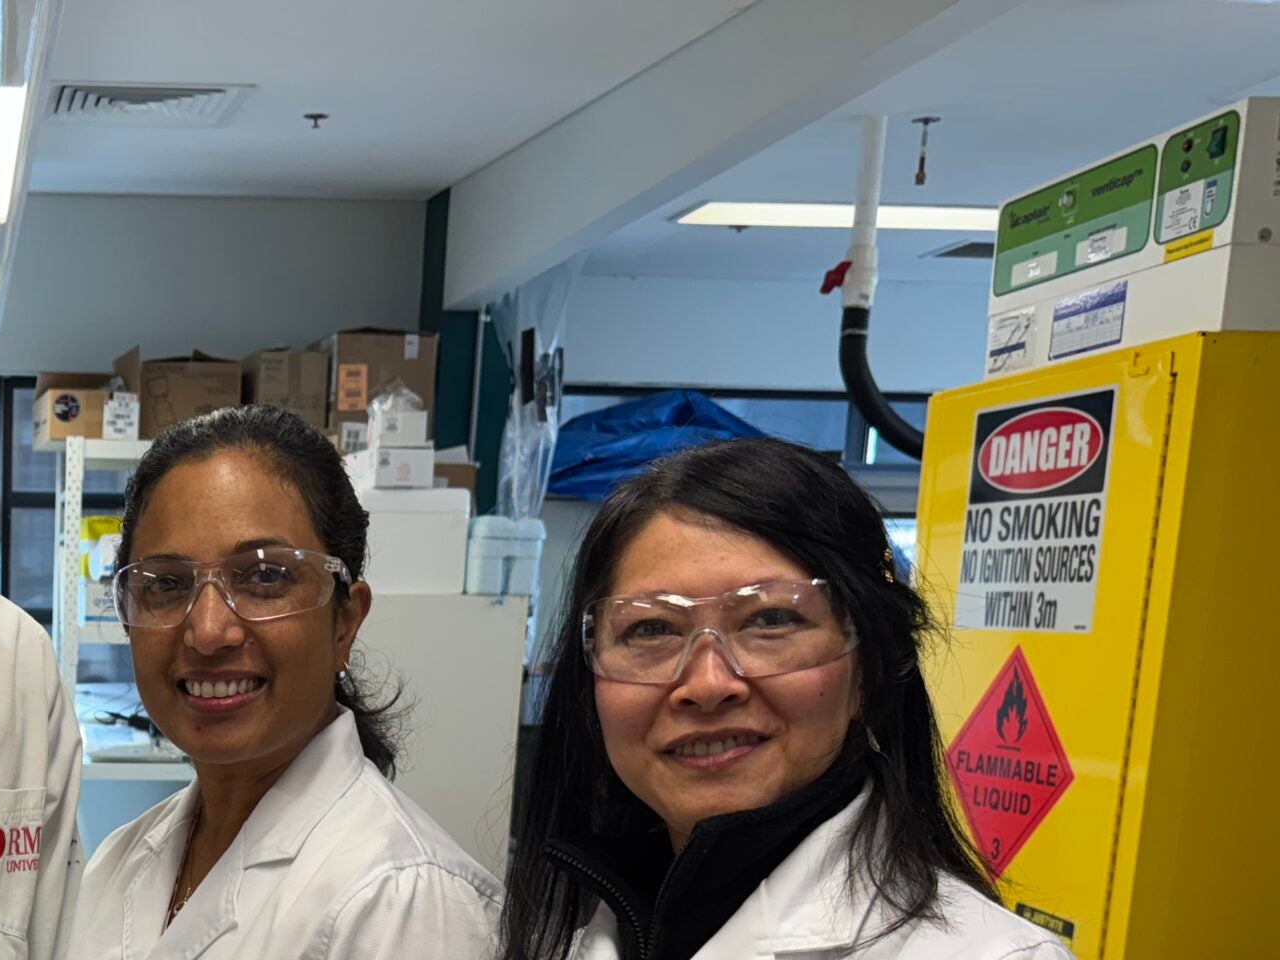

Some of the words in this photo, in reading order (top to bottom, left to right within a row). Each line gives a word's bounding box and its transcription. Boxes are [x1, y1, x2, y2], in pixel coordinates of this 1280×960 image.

[988, 422, 1092, 478] DANGER
[965, 506, 993, 544] NO
[997, 498, 1101, 542] SMOKING
[960, 549, 978, 584] NO
[979, 547, 1033, 584] IGNITION
[1033, 543, 1096, 584] SOURCES
[984, 591, 1033, 627] WITHIN
[1034, 591, 1058, 629] 3m
[956, 750, 1058, 787] FLAMMABLE
[972, 785, 1033, 816] LIQUID
[7, 825, 43, 856] RM
[990, 837, 1001, 861] 3
[6, 860, 39, 873] UNIVE
